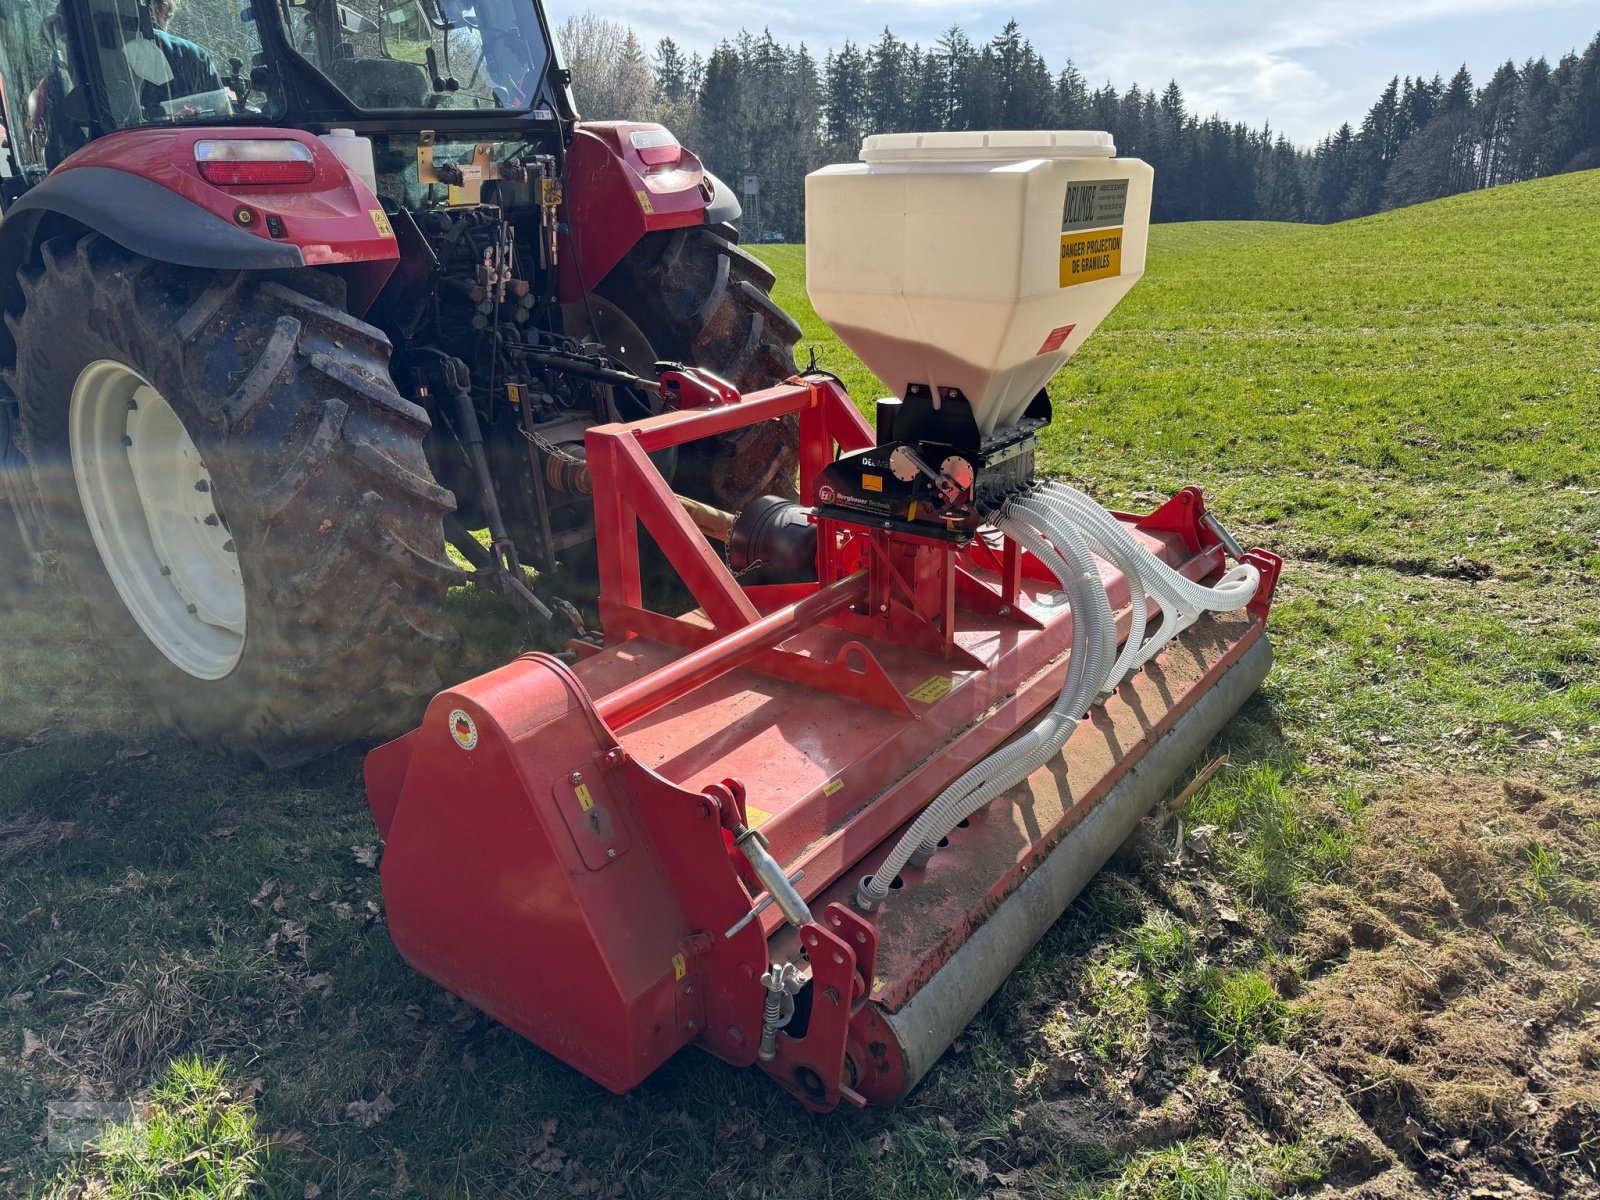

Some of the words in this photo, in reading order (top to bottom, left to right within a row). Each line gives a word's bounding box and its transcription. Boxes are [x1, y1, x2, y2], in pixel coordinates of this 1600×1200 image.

[1064, 186, 1096, 223] DELIMBE
[1062, 241, 1085, 258] DANGER
[1087, 237, 1120, 254] PROJECTION
[1072, 260, 1080, 274] DE
[1082, 255, 1110, 272] GRANULES
[837, 493, 867, 505] Bergbauer
[868, 500, 891, 511] Technik
